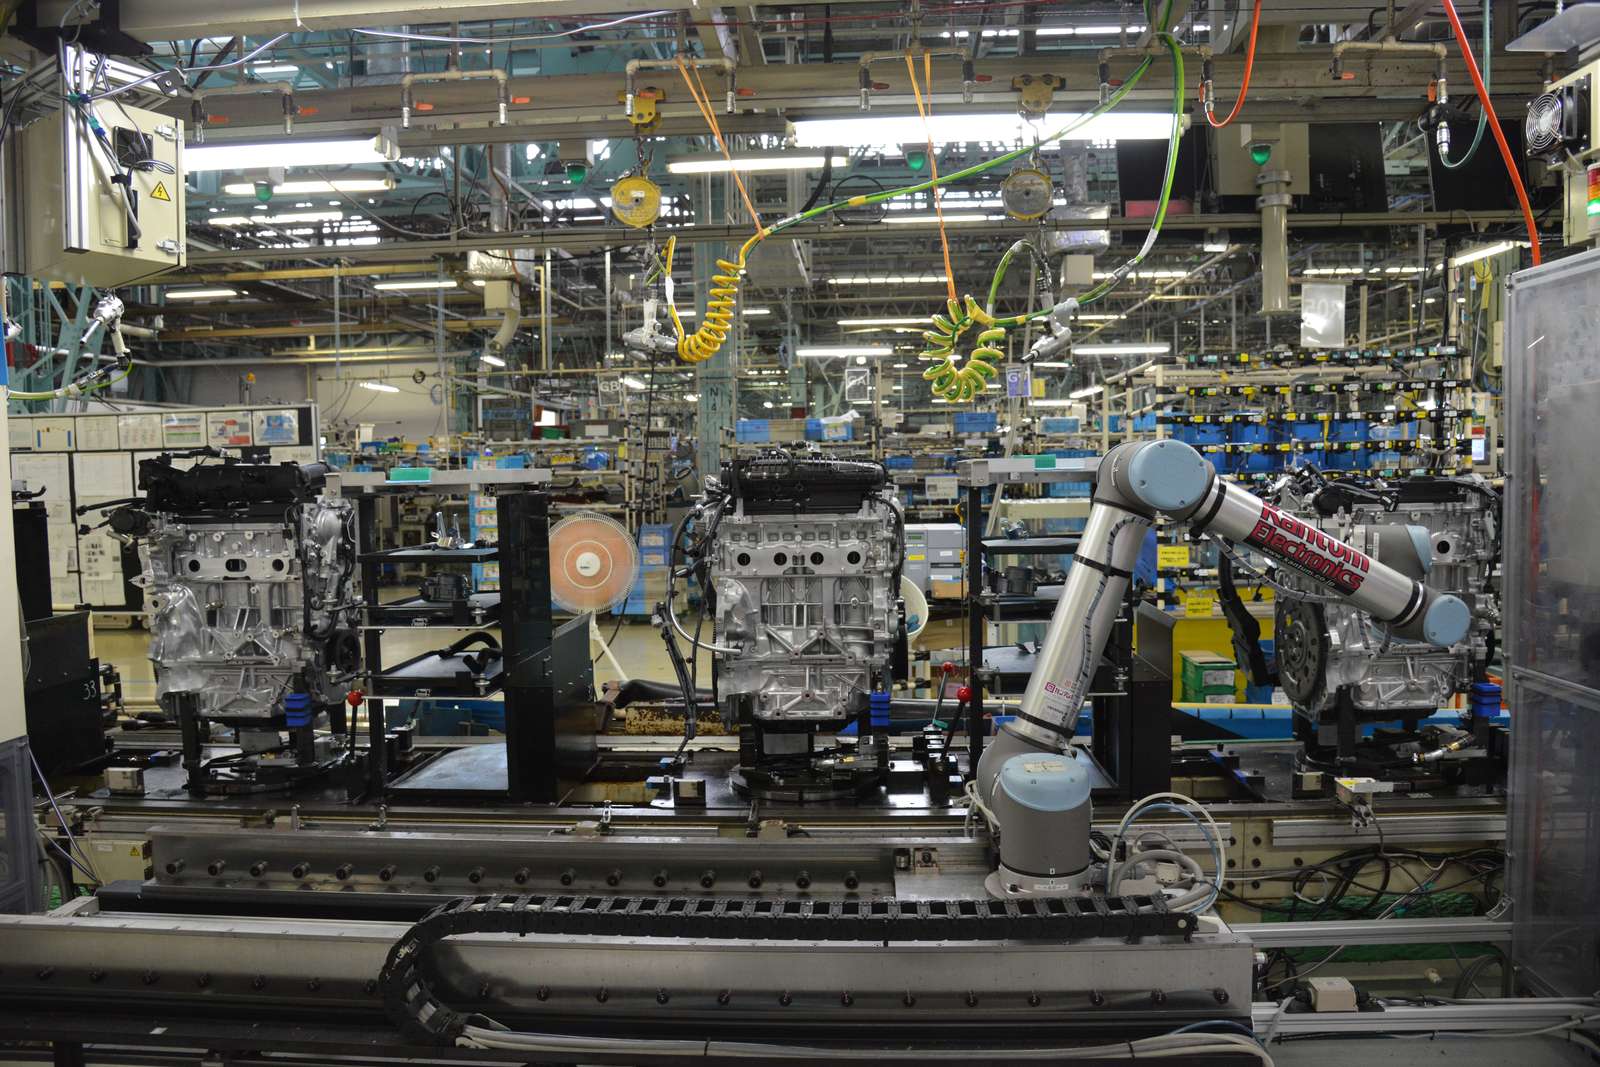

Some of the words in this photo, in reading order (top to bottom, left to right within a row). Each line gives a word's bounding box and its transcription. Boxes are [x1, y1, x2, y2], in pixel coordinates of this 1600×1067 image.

[599, 381, 621, 392] GB
[1249, 519, 1365, 591] Electronics
[1261, 501, 1371, 574] Kantum
[1262, 547, 1337, 587] www.kantum.co.jp
